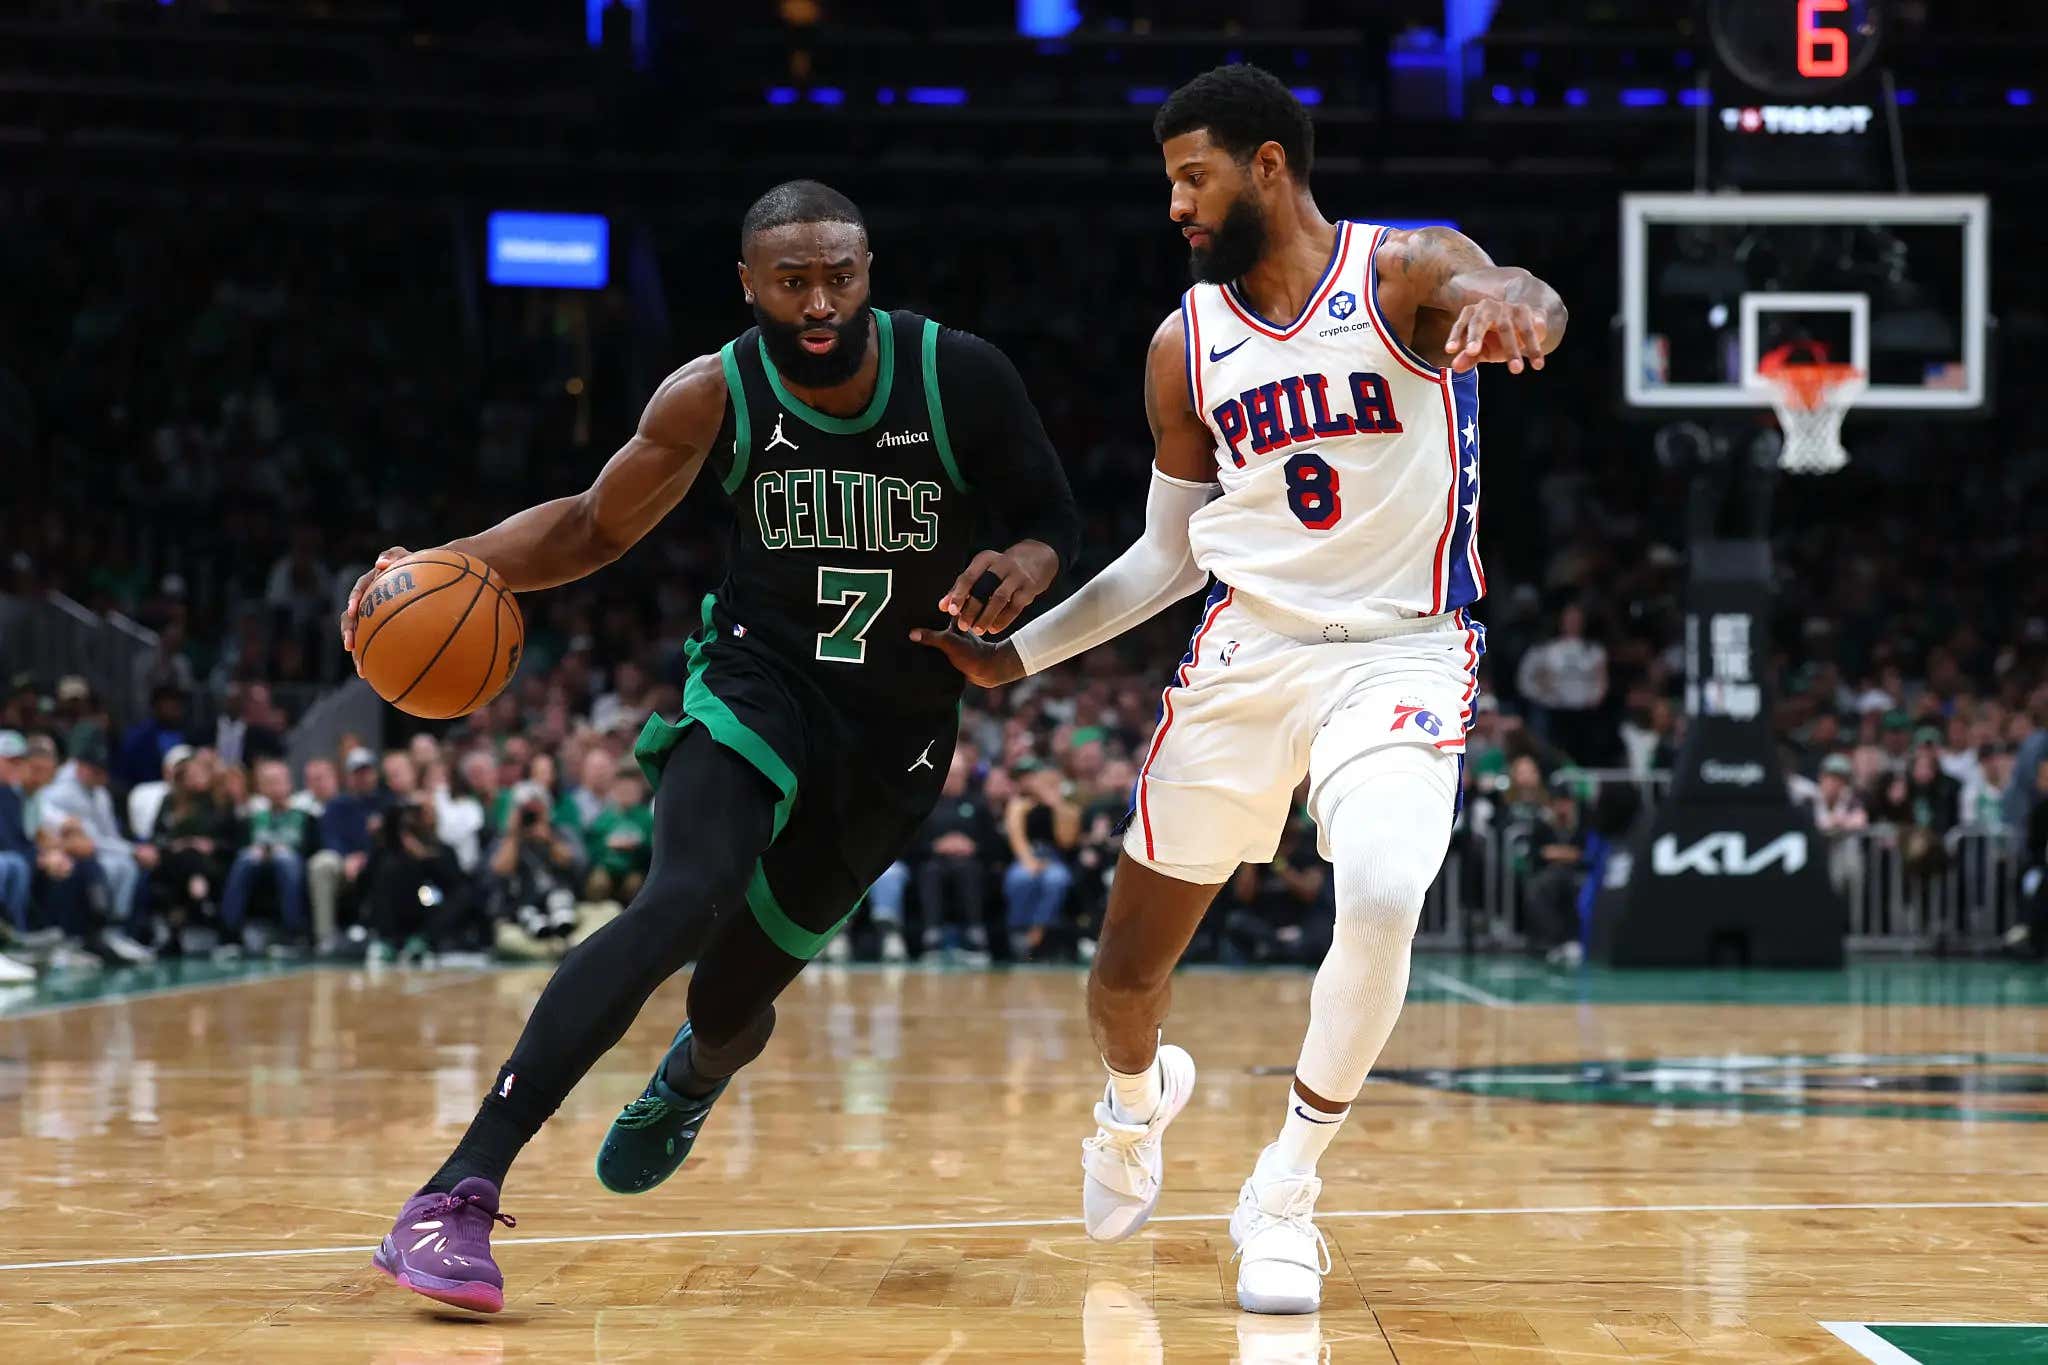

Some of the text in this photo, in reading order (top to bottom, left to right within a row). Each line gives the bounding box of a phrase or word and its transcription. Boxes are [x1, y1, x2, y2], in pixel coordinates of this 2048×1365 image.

[1797, 0, 1849, 78] 6
[1319, 321, 1371, 338] crypto.com
[876, 430, 929, 448] Amica
[1212, 371, 1404, 470] PHILA
[754, 468, 942, 553] CELTICS
[1283, 453, 1342, 530] 8
[815, 565, 893, 664] 7
[1390, 704, 1443, 737] 76
